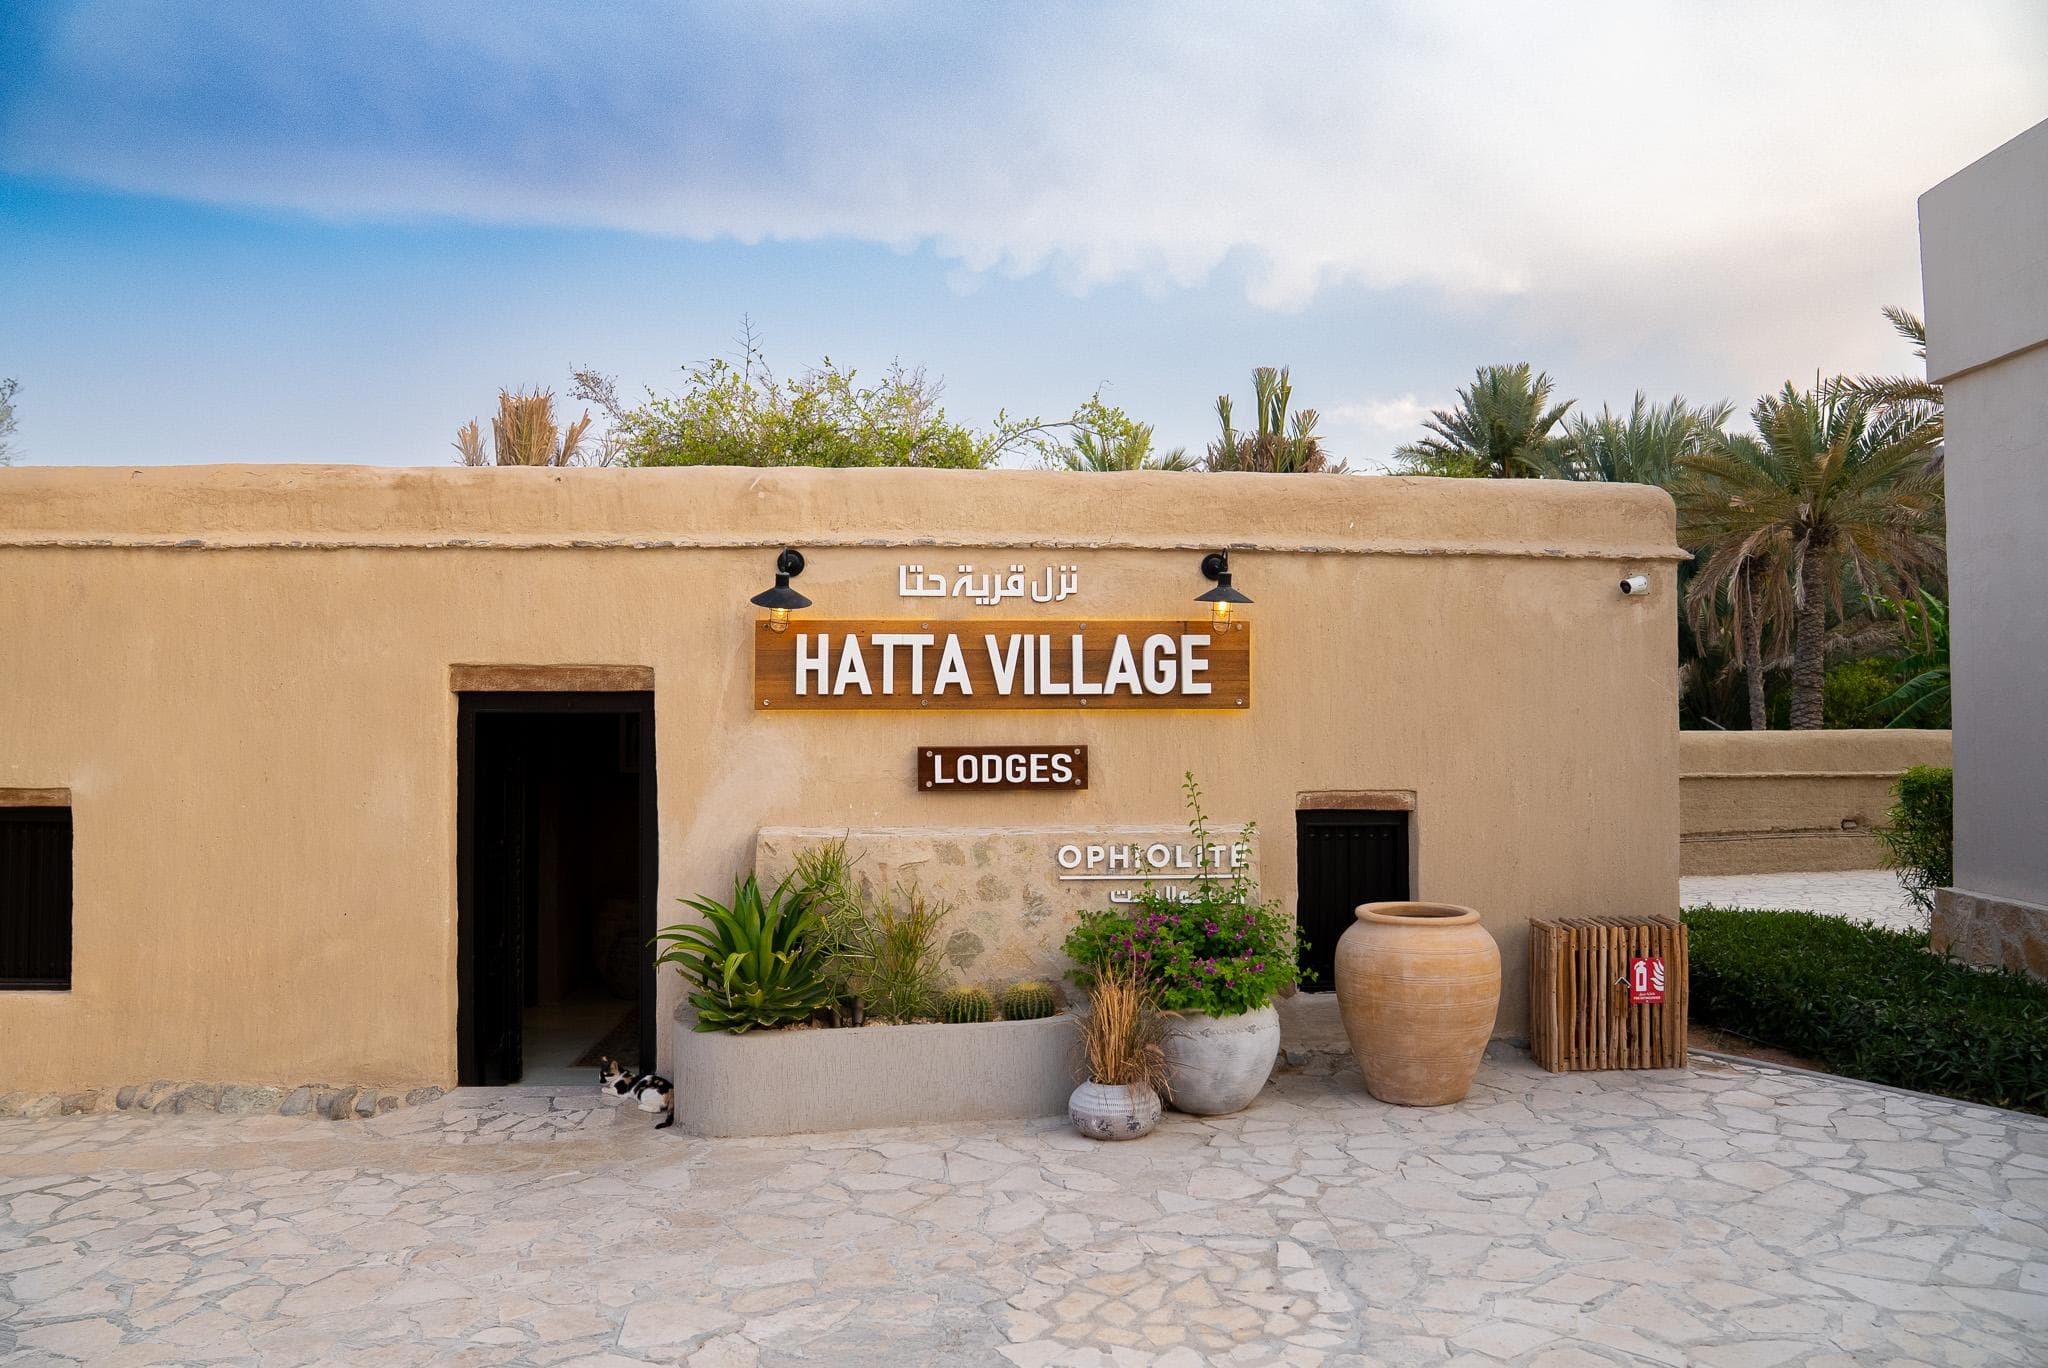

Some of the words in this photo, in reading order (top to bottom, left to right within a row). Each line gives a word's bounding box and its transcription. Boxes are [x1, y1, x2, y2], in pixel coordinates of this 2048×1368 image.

[898, 564, 947, 598] حتا
[951, 564, 1025, 606] قرية
[1031, 564, 1078, 603] نزل
[795, 633, 973, 696] HATTA
[984, 633, 1213, 696] VILLAGE
[933, 753, 1073, 785] LODGES
[1057, 843, 1249, 870] OPHIOLITE
